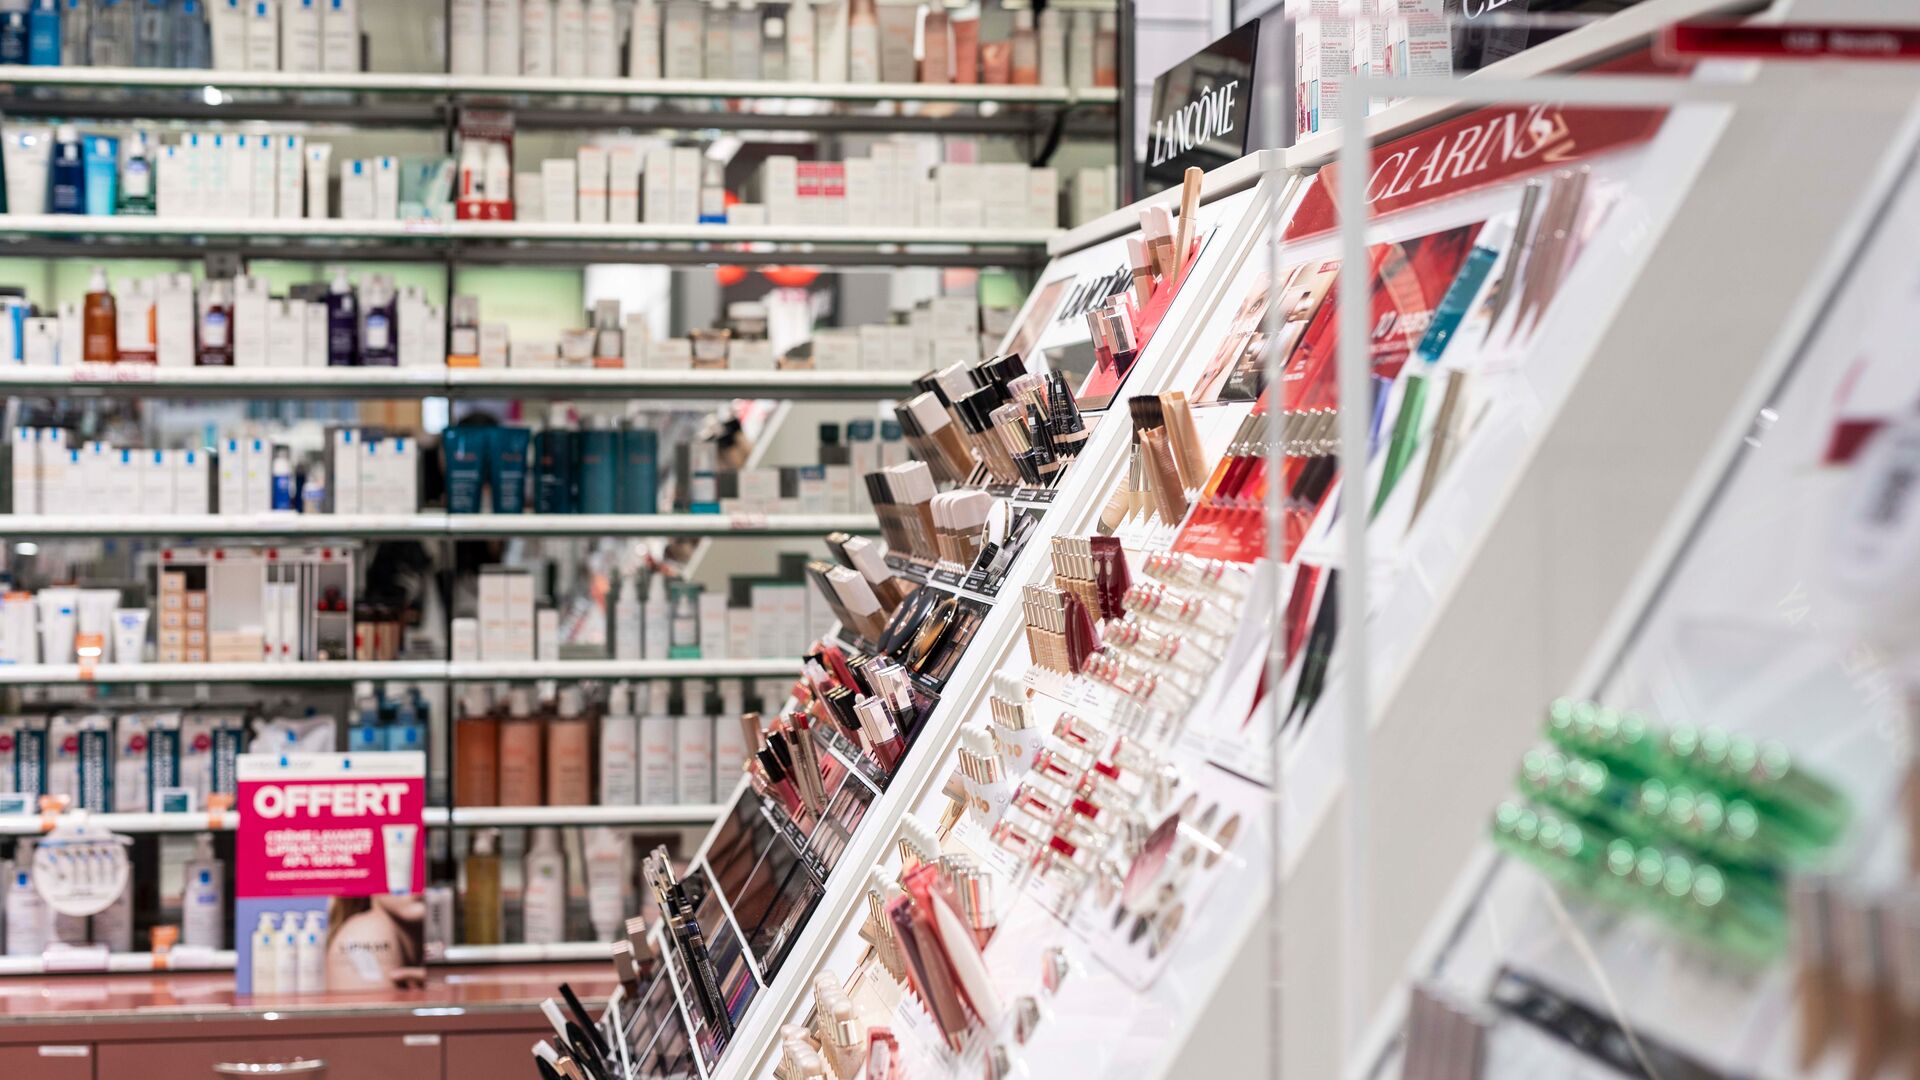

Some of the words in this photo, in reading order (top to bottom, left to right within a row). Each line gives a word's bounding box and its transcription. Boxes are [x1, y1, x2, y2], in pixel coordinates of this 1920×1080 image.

[1151, 80, 1238, 167] LANCÔME
[1364, 102, 1554, 205] CLARINS
[253, 782, 409, 819] OFFERT
